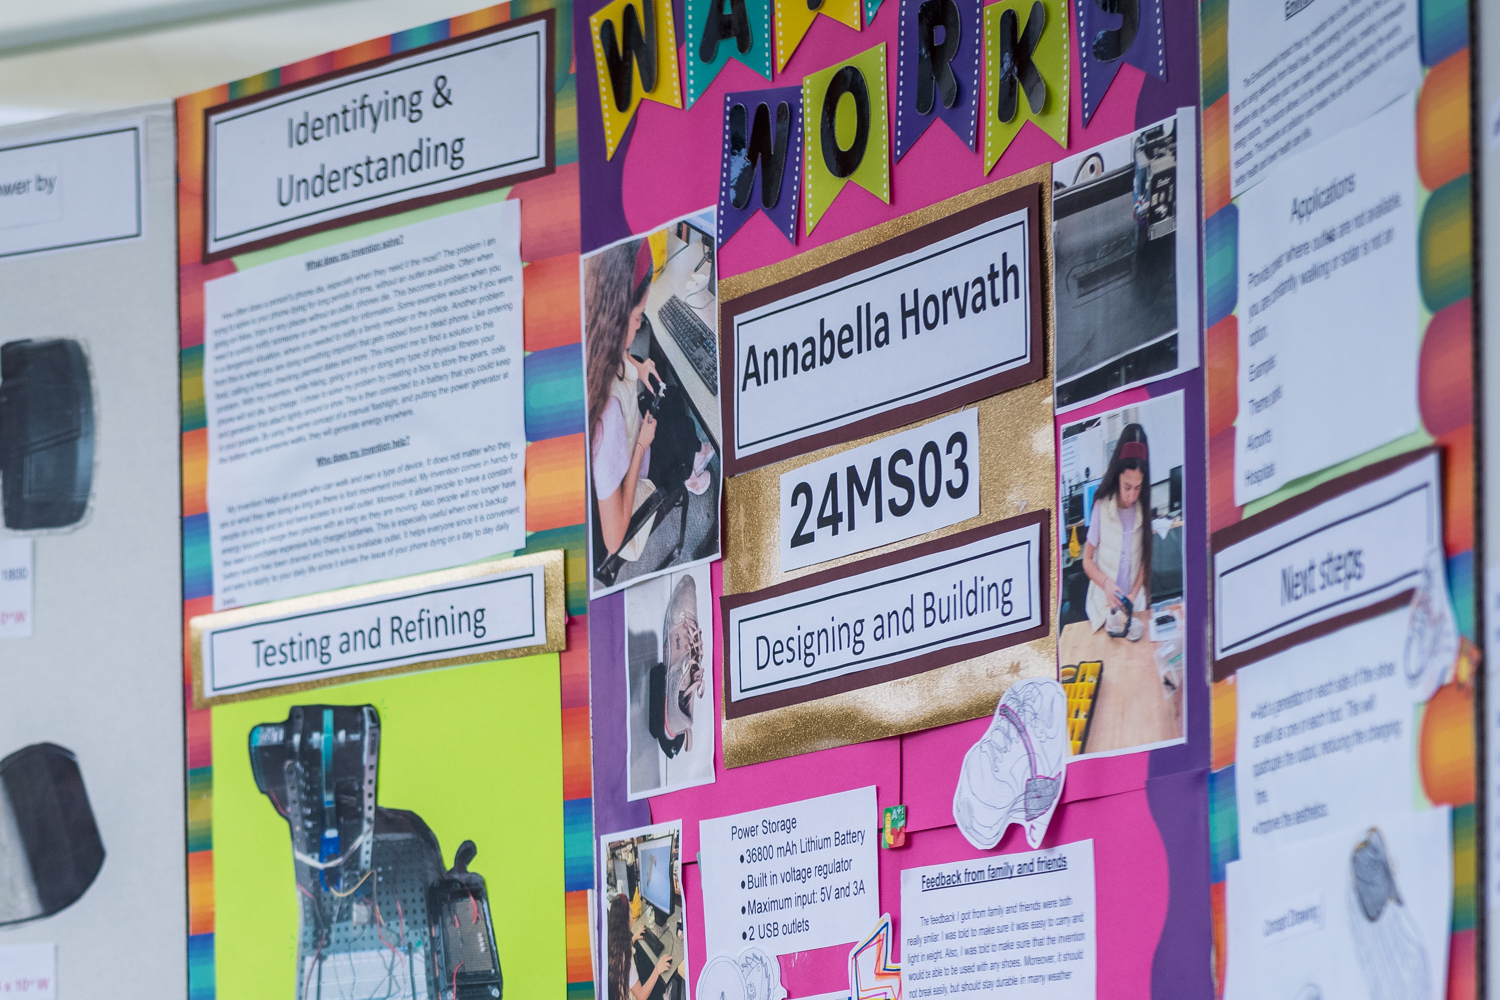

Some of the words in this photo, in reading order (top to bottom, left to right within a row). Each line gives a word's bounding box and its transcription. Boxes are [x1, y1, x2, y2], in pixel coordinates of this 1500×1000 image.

[287, 89, 423, 149] Identifying
[432, 74, 453, 109] &
[35, 172, 57, 195] by
[276, 135, 465, 207] Understanding
[741, 301, 890, 392] Annabella
[900, 252, 1020, 340] Horvath
[790, 431, 970, 549] 24MS03
[1280, 556, 1318, 607] Next
[1319, 548, 1365, 595] steps
[252, 632, 332, 669] Testing
[339, 617, 382, 656] and
[390, 605, 487, 646] Refining
[756, 617, 865, 671] Designing
[873, 594, 914, 642] and
[924, 577, 1014, 629] Building
[731, 824, 759, 841] Power
[761, 817, 797, 835] Storage
[746, 846, 774, 864] 36800
[776, 841, 798, 858] mAh
[800, 836, 832, 854] Lithium
[834, 829, 866, 848] Battery
[747, 872, 768, 890] Built
[770, 869, 778, 882] in
[780, 866, 812, 885] voltage
[814, 858, 853, 880] regulator
[921, 870, 962, 890] Feedback
[964, 866, 985, 882] from
[987, 862, 1014, 881] family
[1016, 858, 1034, 874] and
[1036, 854, 1068, 871] friends
[748, 896, 792, 915] Maximum
[794, 891, 818, 909] input:
[820, 885, 833, 902] 5V
[834, 882, 850, 898] and
[852, 880, 866, 896] 3A
[748, 926, 755, 941] 2
[758, 922, 780, 940] USB
[781, 918, 810, 935] outlets
